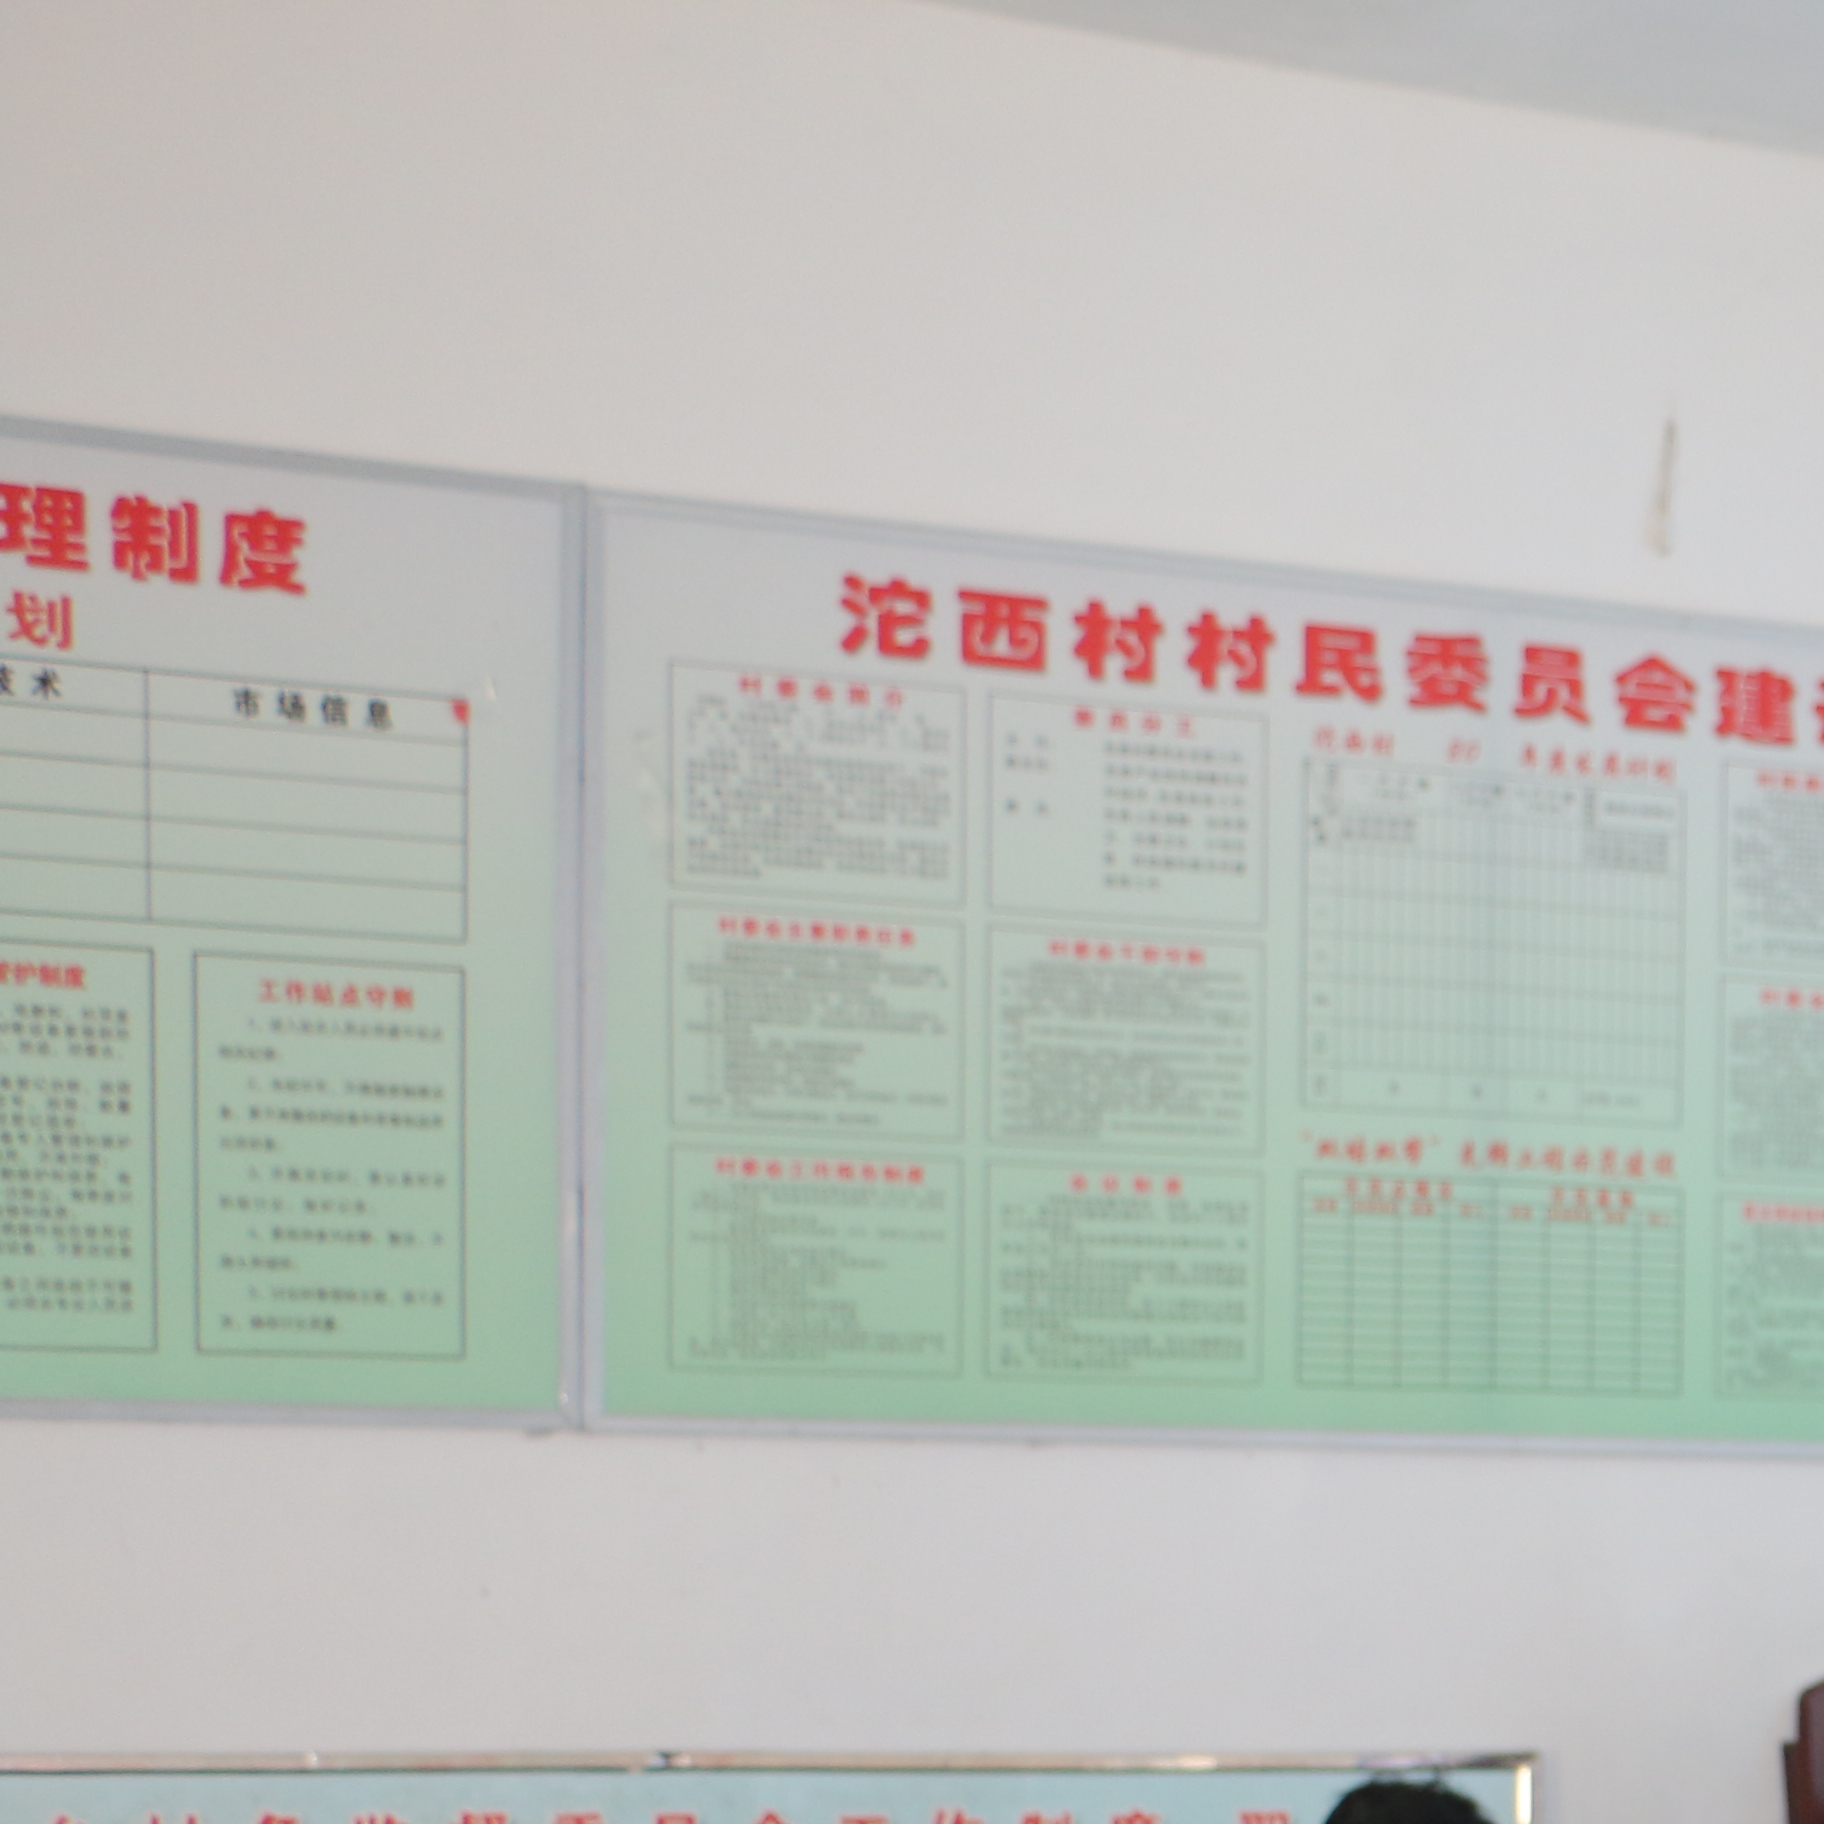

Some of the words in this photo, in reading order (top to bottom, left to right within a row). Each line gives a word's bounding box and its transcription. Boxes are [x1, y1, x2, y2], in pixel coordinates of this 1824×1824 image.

[8, 591, 73, 650] 划
[233, 687, 392, 731] 市场信息
